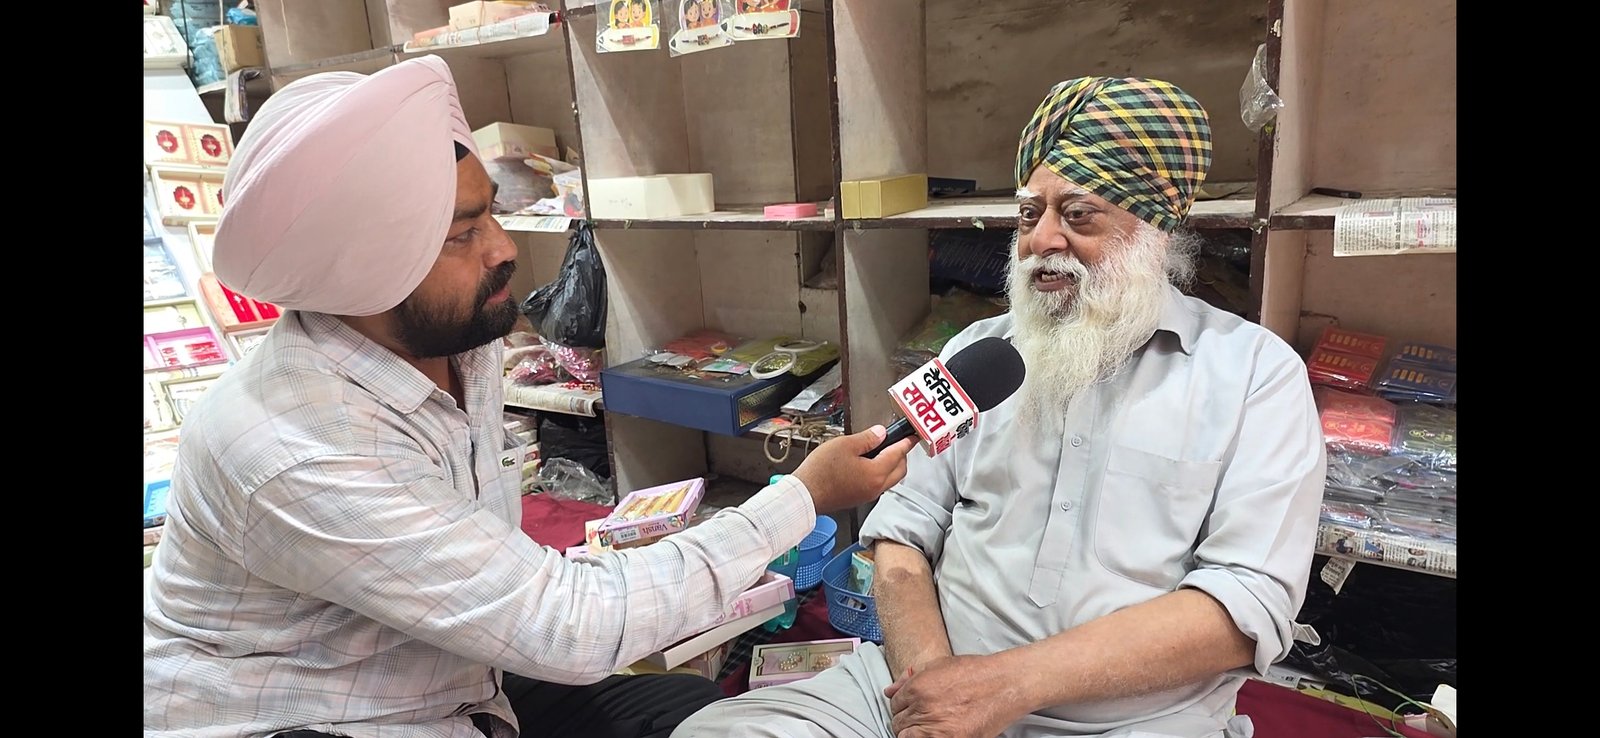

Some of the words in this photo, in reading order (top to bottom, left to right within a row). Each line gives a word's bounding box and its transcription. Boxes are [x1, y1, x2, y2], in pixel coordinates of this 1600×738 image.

[902, 381, 947, 433] सवेरा
[923, 367, 964, 416] दैनिक
[642, 523, 668, 535] Vansh
